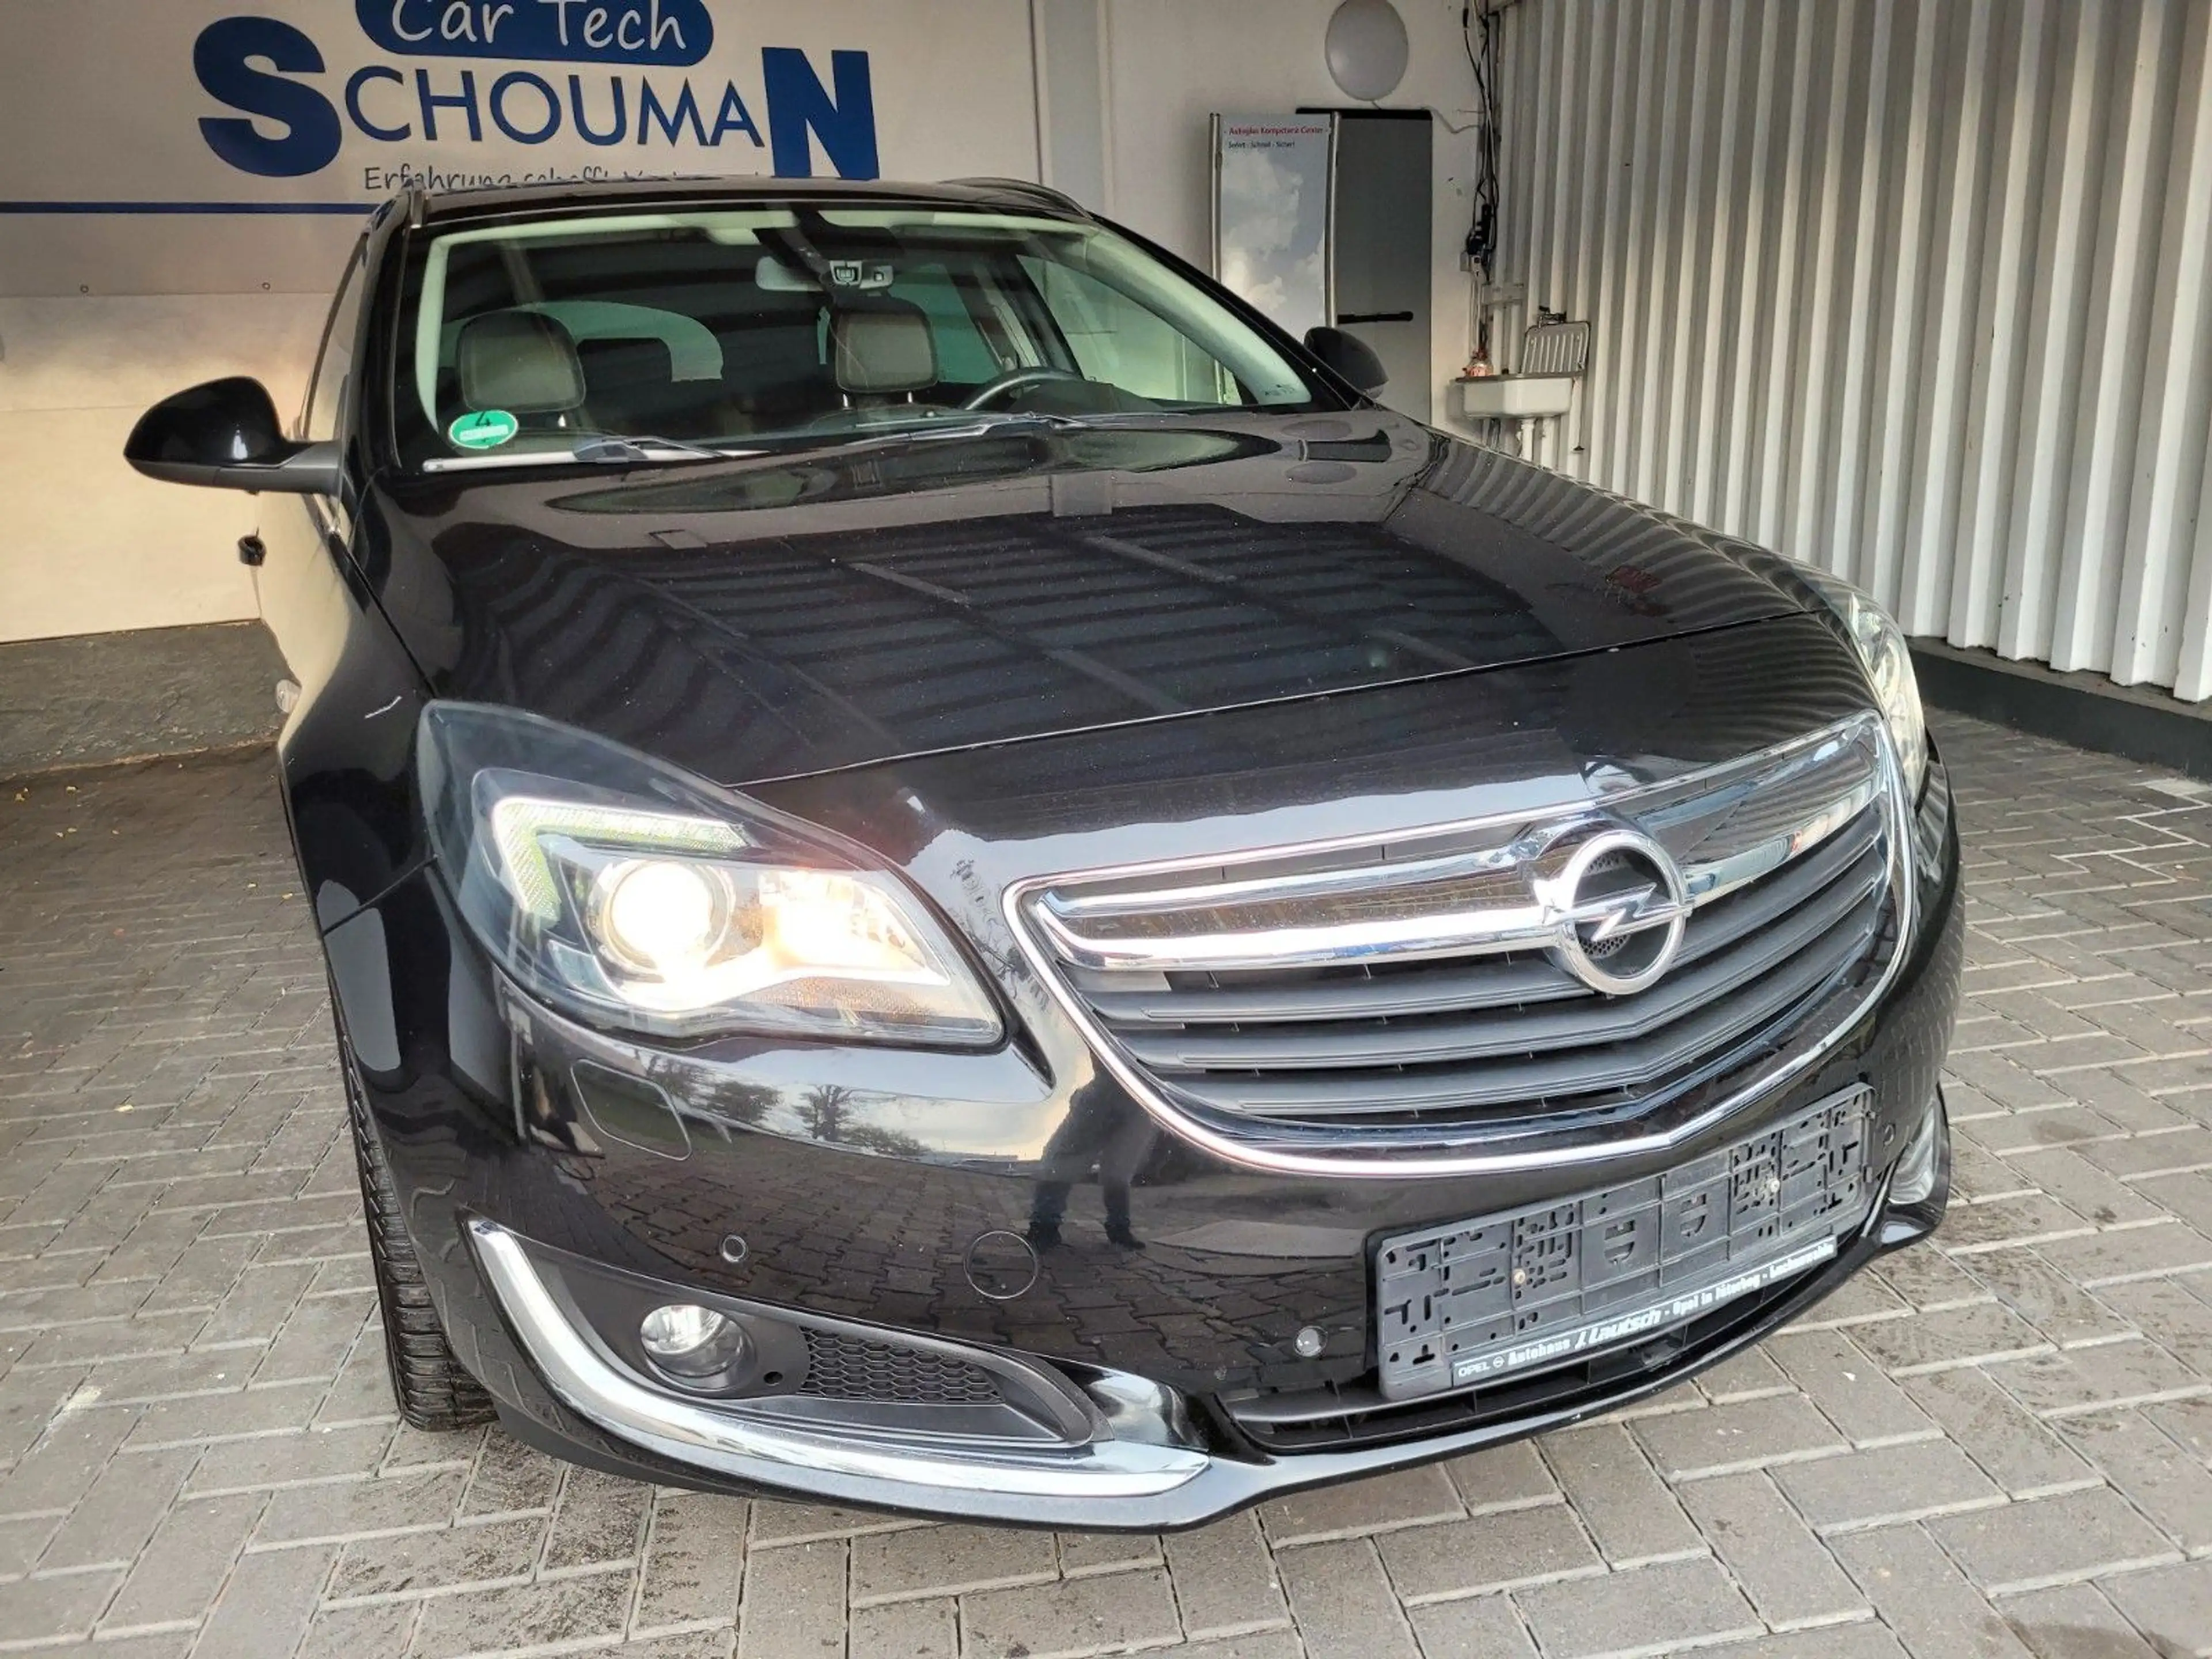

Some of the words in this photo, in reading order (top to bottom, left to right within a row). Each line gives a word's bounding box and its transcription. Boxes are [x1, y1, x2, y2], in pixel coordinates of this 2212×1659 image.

[392, 0, 513, 43] Car
[537, 0, 687, 50] Tech
[1459, 1361, 1491, 1378] OPEL
[1508, 1338, 1571, 1366] Autohaus
[1672, 1295, 1699, 1316] Opel
[1700, 1292, 1713, 1305] in
